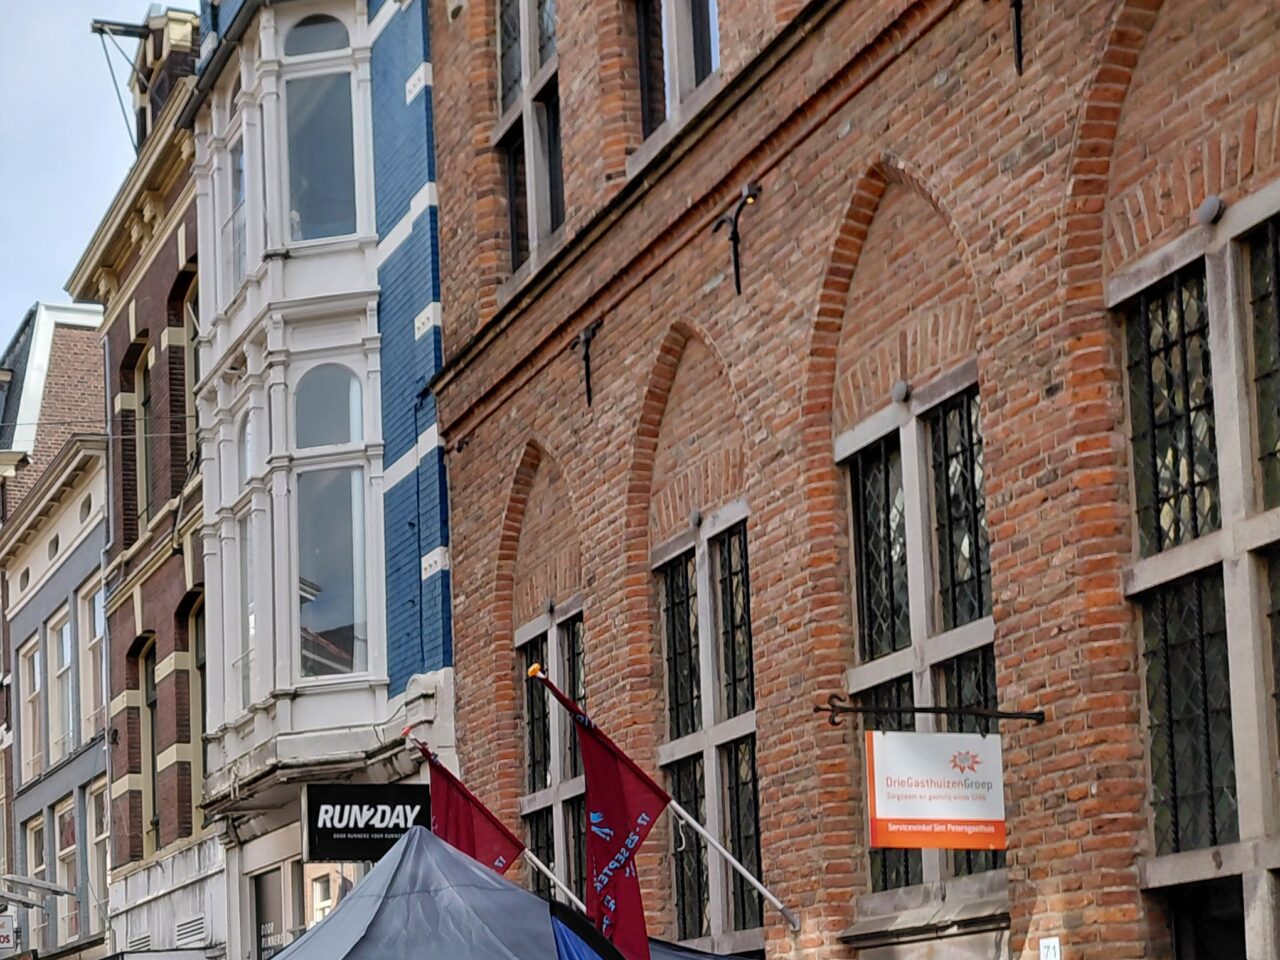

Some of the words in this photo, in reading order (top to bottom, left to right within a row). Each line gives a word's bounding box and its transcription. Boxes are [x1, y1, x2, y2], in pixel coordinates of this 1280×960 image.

[886, 776, 993, 792] DrieGasthuizenGroep
[318, 804, 420, 828] RUN2DAY
[1043, 945, 1057, 960] 71
